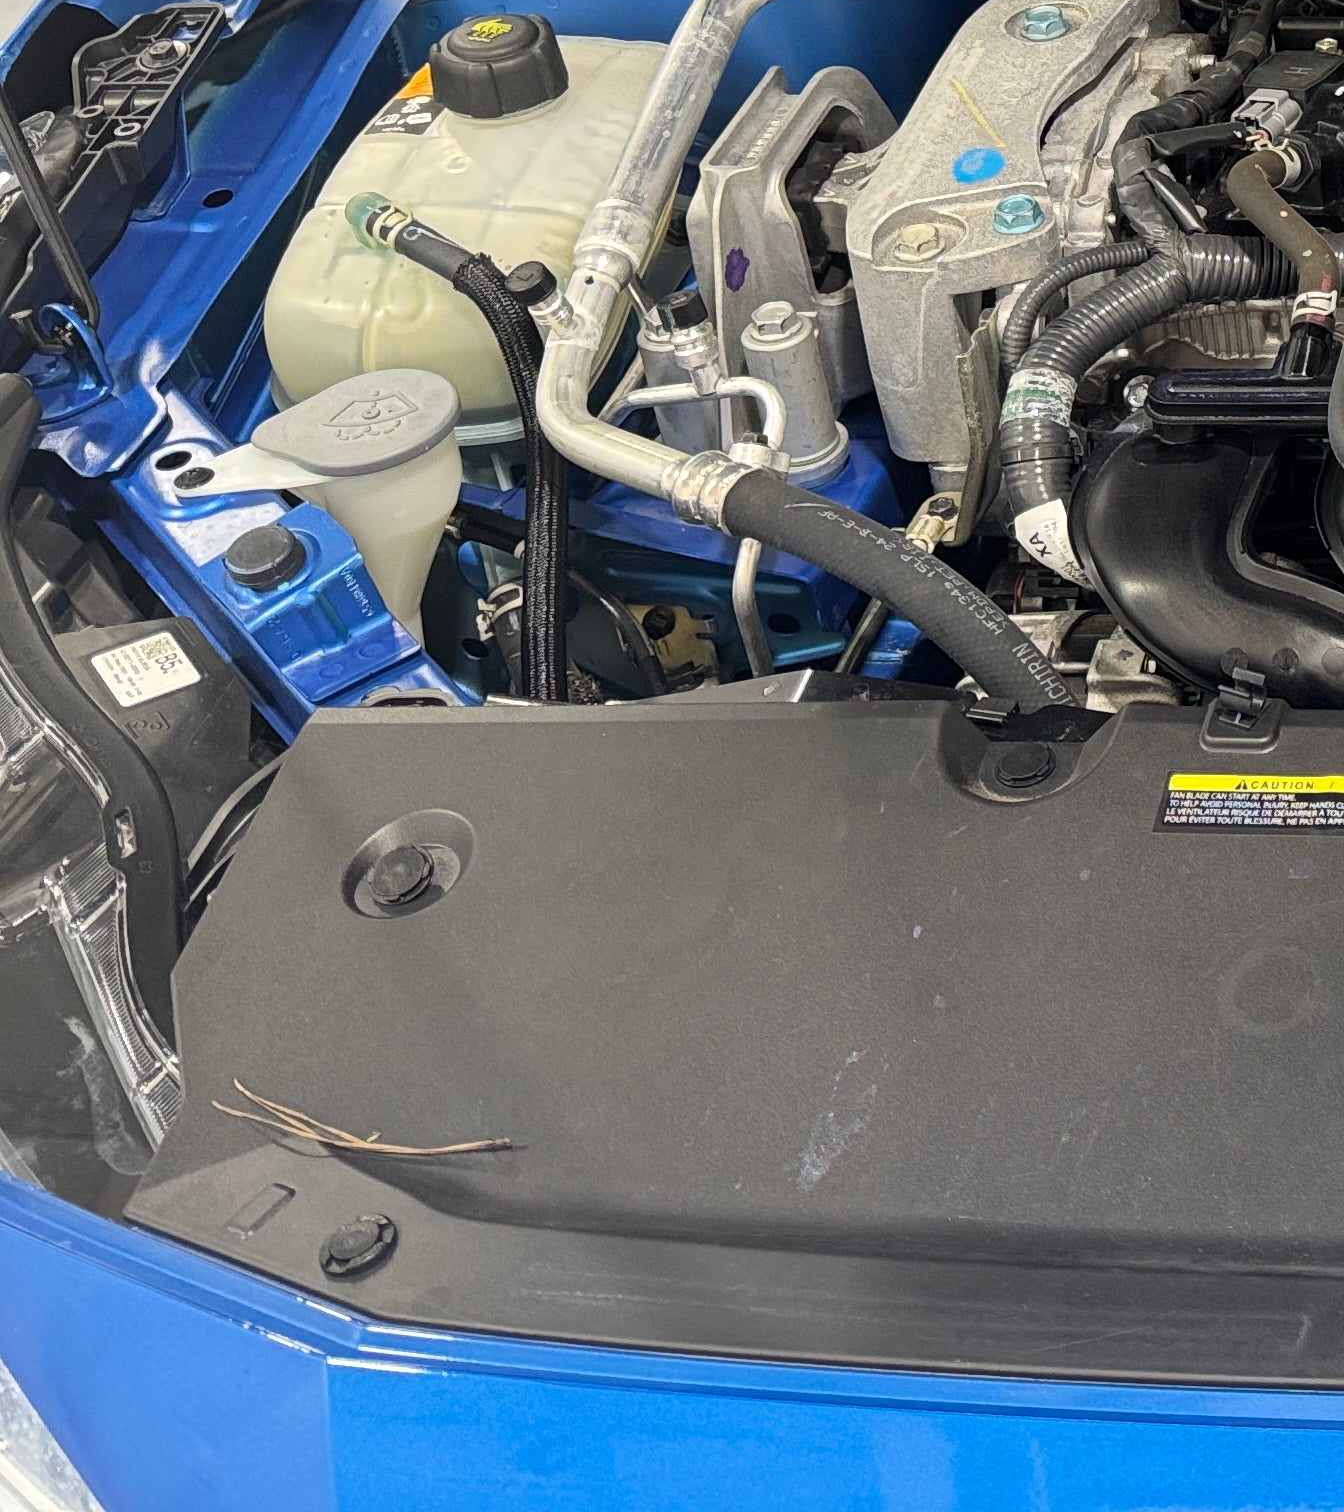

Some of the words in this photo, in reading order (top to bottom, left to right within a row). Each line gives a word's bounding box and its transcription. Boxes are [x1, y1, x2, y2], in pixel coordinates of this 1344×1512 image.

[1029, 531, 1054, 558] XA
[1011, 642, 1081, 707] ICHIRIN
[1250, 780, 1315, 790] CAUTION
[1186, 792, 1210, 800] BLADE
[1210, 792, 1227, 800] CAN
[1200, 800, 1223, 808] AVOID
[1224, 800, 1262, 808] PERSONAL
[1290, 801, 1309, 809] KEEP
[1309, 801, 1336, 809] HANDS
[1177, 808, 1231, 816] VENTILATEUR
[1231, 809, 1260, 817] RISQUE
[1261, 809, 1272, 817] DE
[1217, 816, 1243, 824] TOUTE
